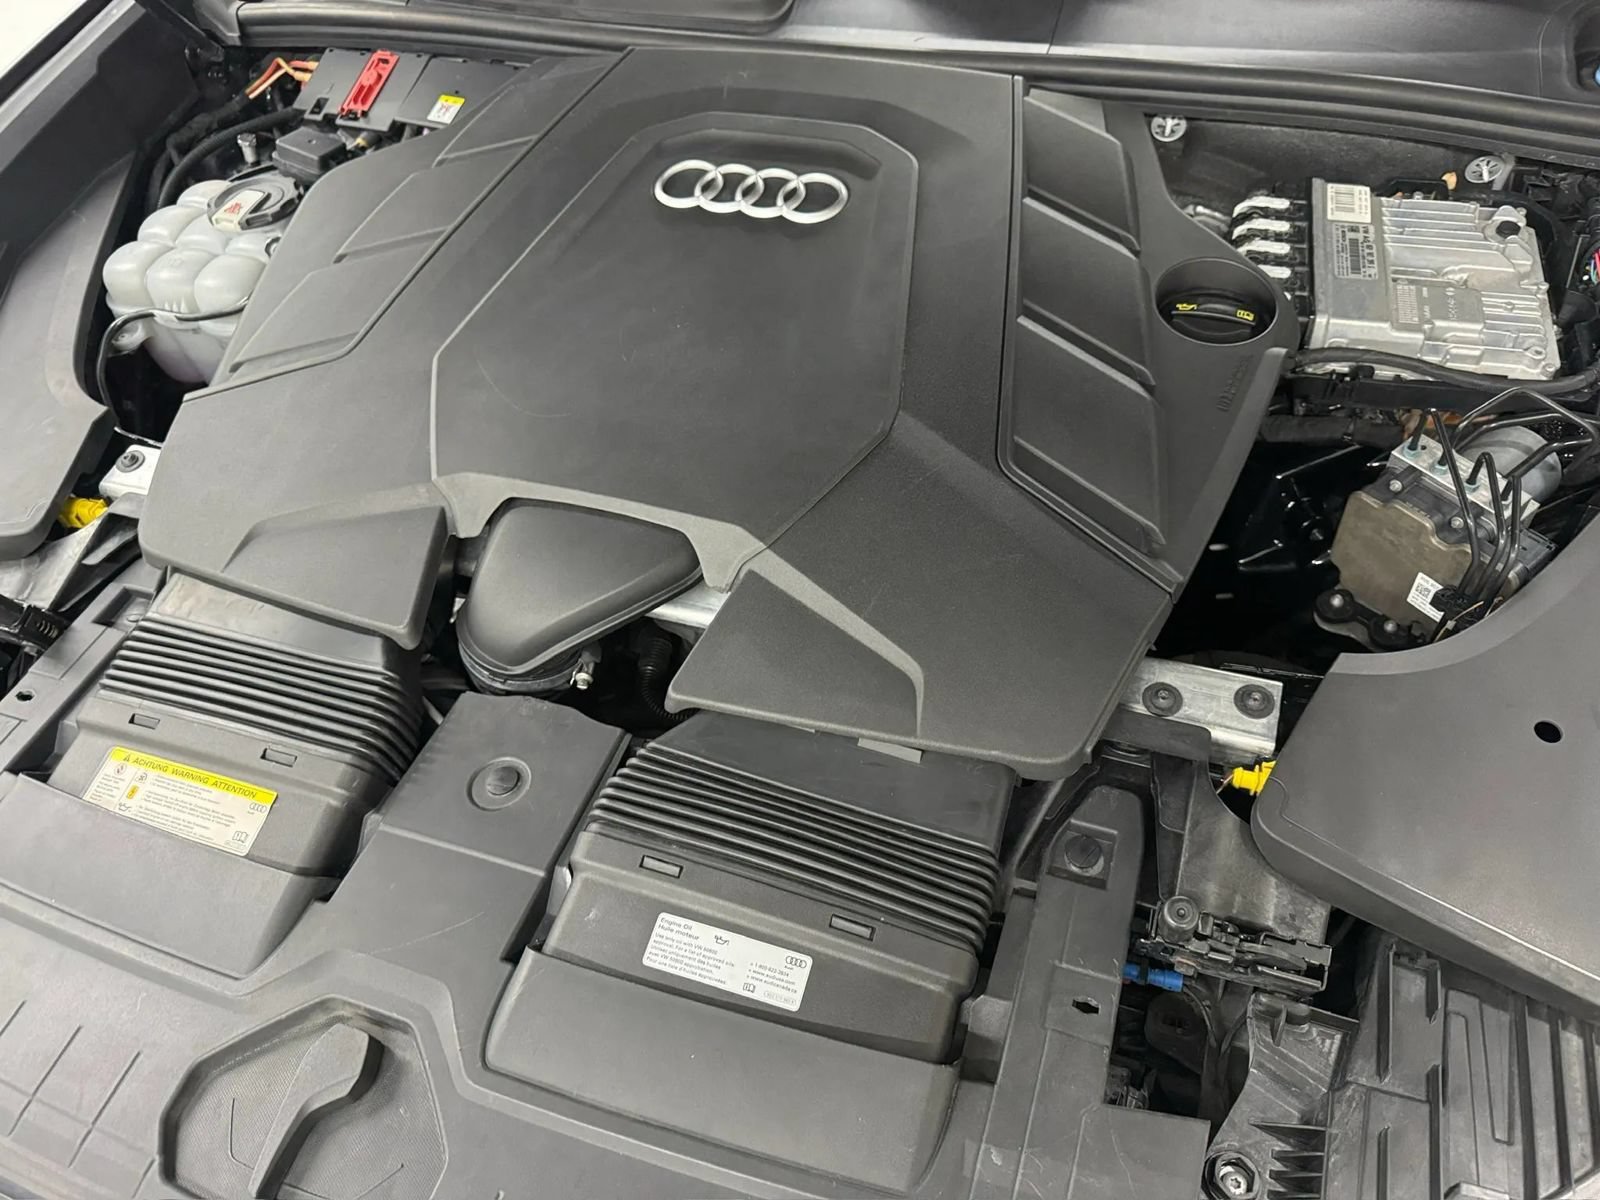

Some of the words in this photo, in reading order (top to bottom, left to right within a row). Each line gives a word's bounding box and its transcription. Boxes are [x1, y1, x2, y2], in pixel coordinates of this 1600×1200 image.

[133, 757, 169, 773] ACHTUNG
[171, 767, 210, 784] WARNING
[211, 779, 258, 799] ATTENTION
[660, 917, 681, 928] Engine
[658, 923, 675, 932] Huile
[675, 930, 699, 940] moteur
